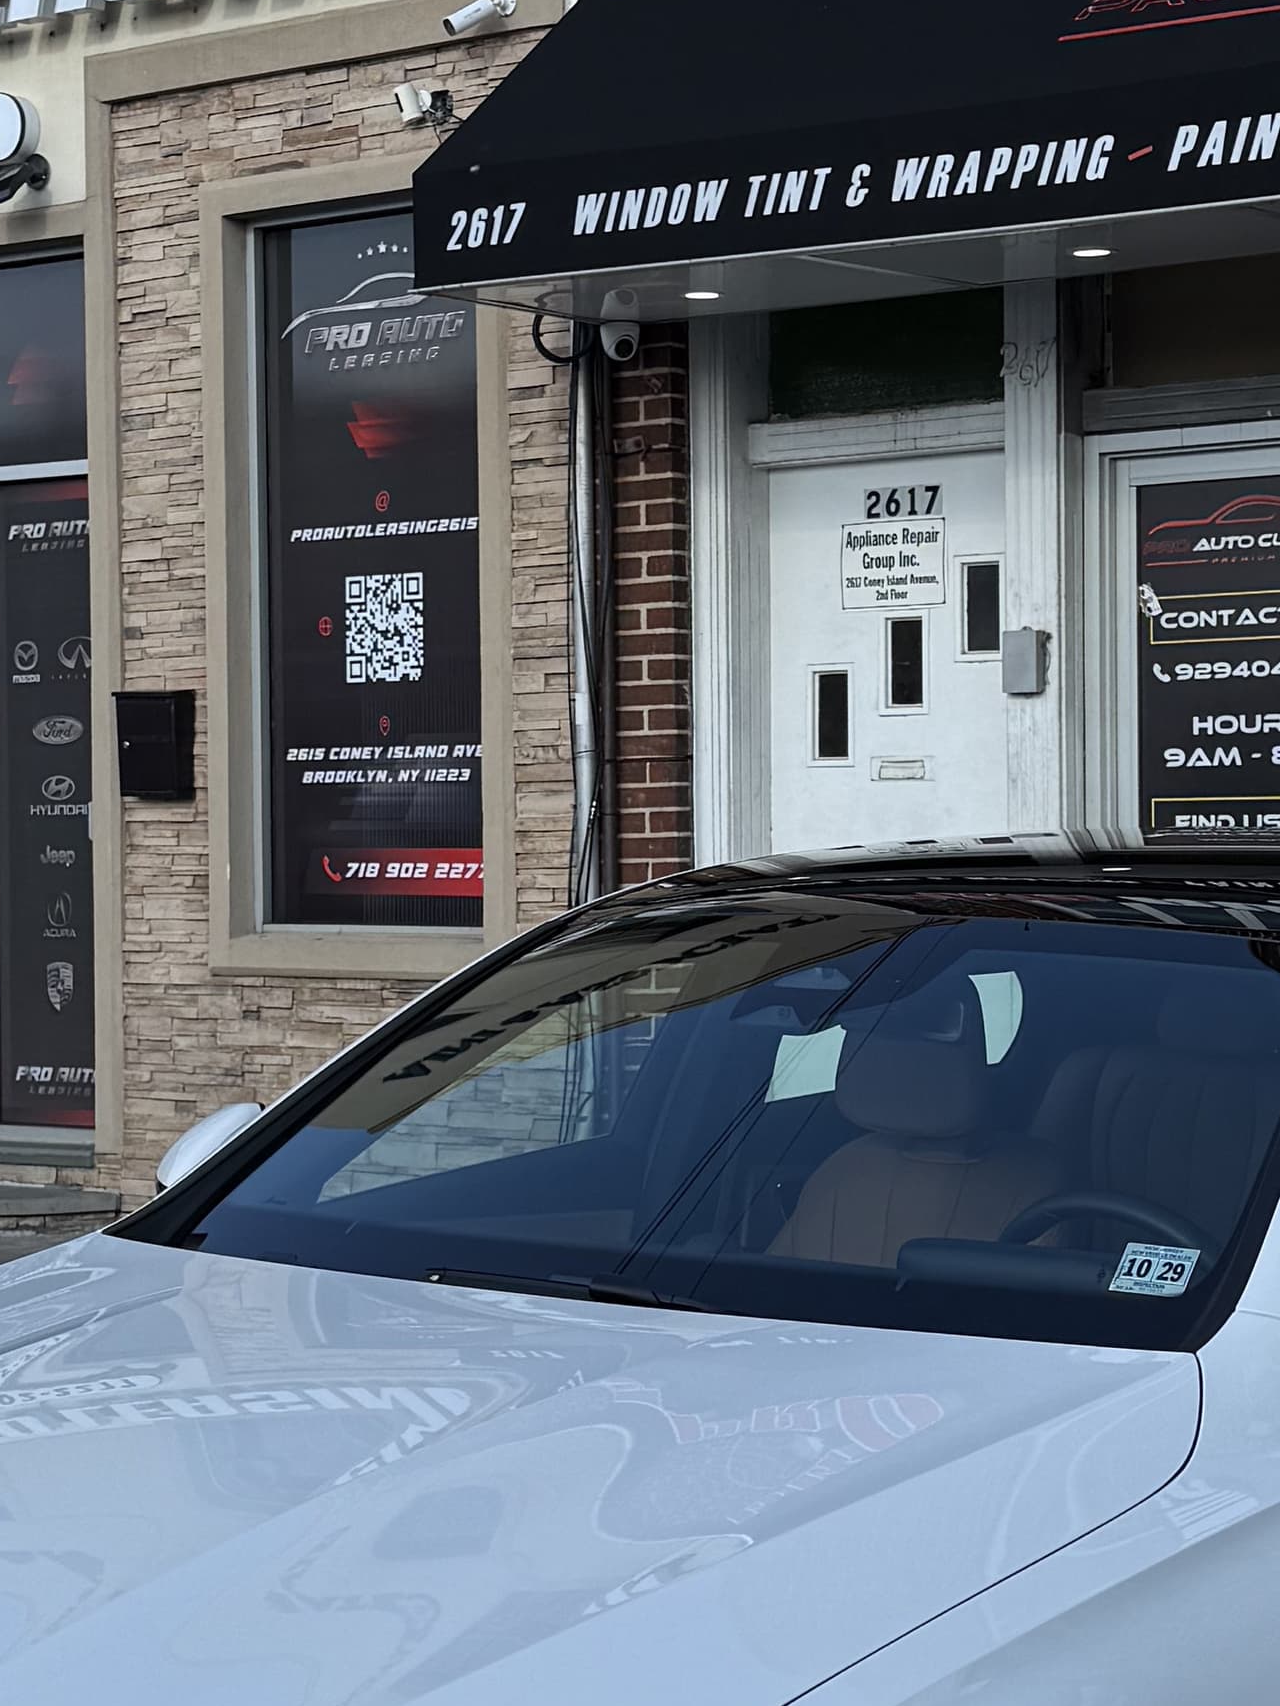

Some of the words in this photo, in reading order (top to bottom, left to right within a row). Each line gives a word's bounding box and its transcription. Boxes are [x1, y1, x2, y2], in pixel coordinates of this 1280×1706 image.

[572, 178, 725, 237] WINDOW
[744, 165, 832, 219] TINT
[846, 163, 871, 207] &
[891, 134, 1115, 202] WRAPPING
[446, 202, 526, 252] 2617
[305, 322, 372, 354] PRO
[376, 310, 466, 346] AUTO
[329, 346, 440, 372] LEASING
[867, 485, 940, 519] 2617
[8, 522, 47, 540] PRO
[48, 520, 90, 537] AUT
[290, 517, 479, 543] PROAUTOLEASING2615
[846, 530, 898, 551] Appliance
[901, 526, 940, 547] Repair
[1193, 535, 1255, 552] AUTO
[863, 552, 895, 571] Group
[899, 550, 920, 568] Inc.
[887, 574, 908, 586] Island
[287, 748, 325, 761] 2615
[329, 747, 383, 760] CONEY
[386, 745, 448, 759] ISLAND
[1163, 747, 1242, 768] 9AM
[302, 769, 393, 784] BROOKLYN,
[398, 769, 420, 782] NY
[424, 768, 471, 782] 11223
[30, 804, 89, 815] HYUNDAI
[1175, 814, 1236, 829] FIND
[345, 862, 380, 879] 718
[385, 862, 429, 879] 902
[43, 928, 76, 938] ACURA
[15, 1066, 53, 1082] PRO
[56, 1067, 96, 1083] AUT
[1122, 1257, 1152, 1278] 10
[1156, 1261, 1186, 1282] 29
